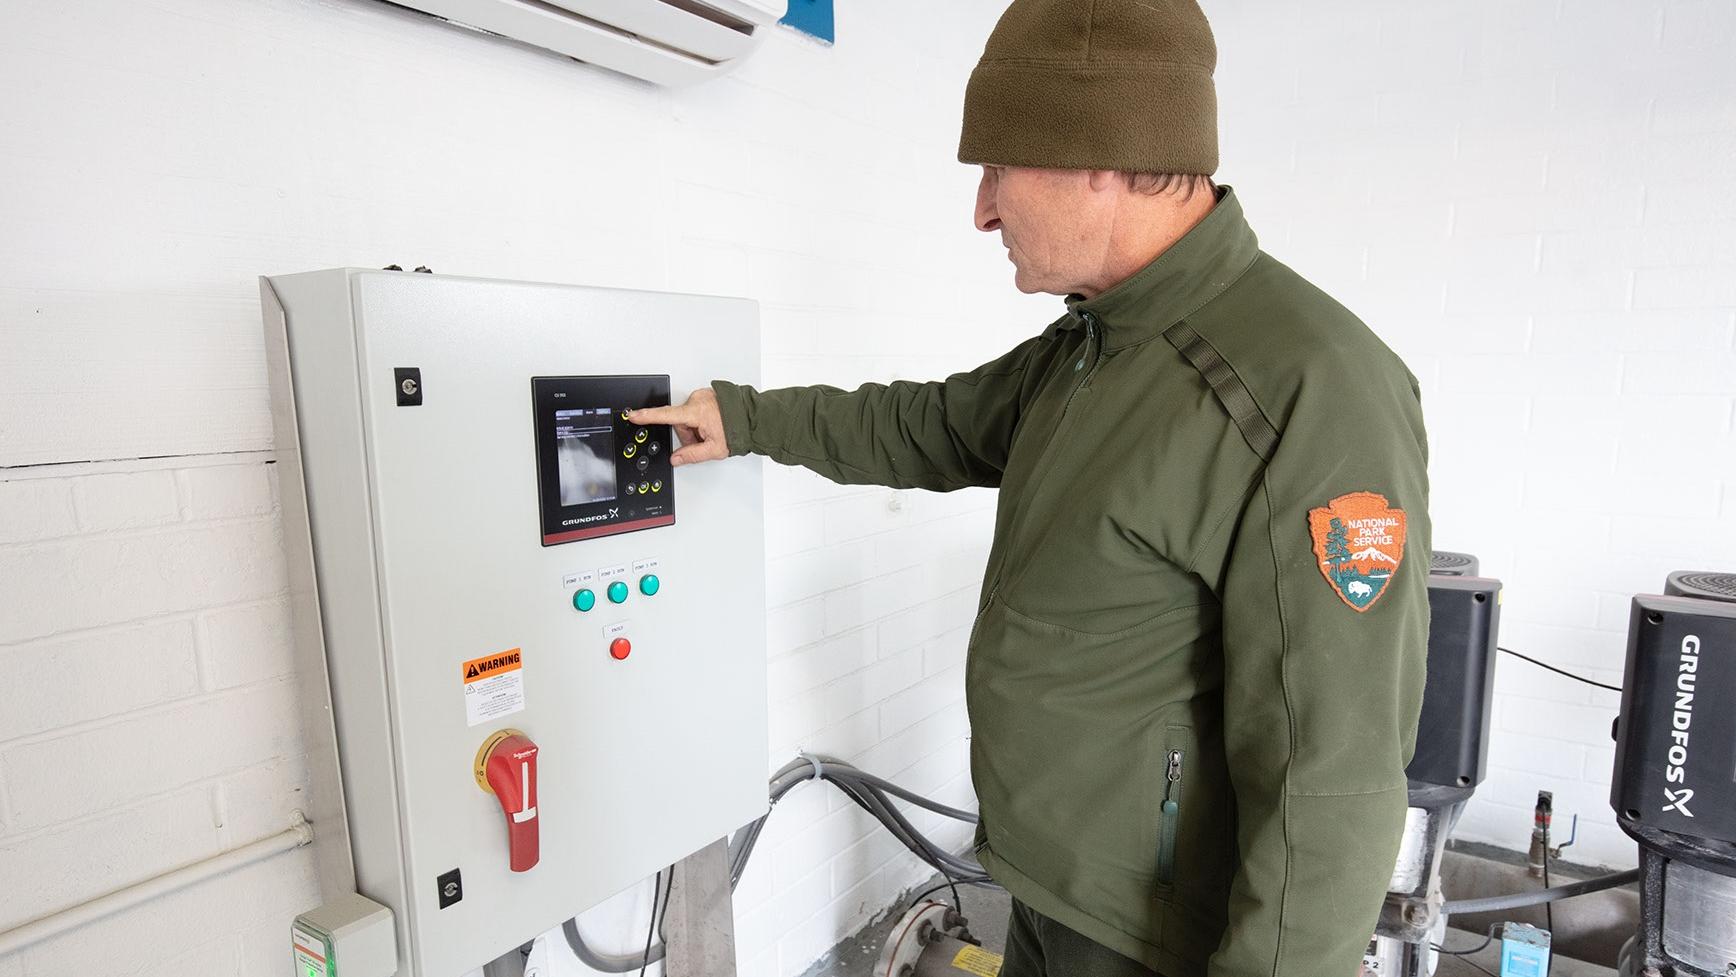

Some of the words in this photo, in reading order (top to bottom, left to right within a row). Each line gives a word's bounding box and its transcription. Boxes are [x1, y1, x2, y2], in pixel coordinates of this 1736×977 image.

[562, 513, 607, 526] GRUNDFOS
[1348, 517, 1399, 528] NATIONAL
[1360, 527, 1385, 537] PARK
[1353, 535, 1393, 547] SERVICE
[478, 653, 520, 673] WARNING
[1666, 634, 1701, 784] GRUNDFOS
[1373, 961, 1379, 969] 2
